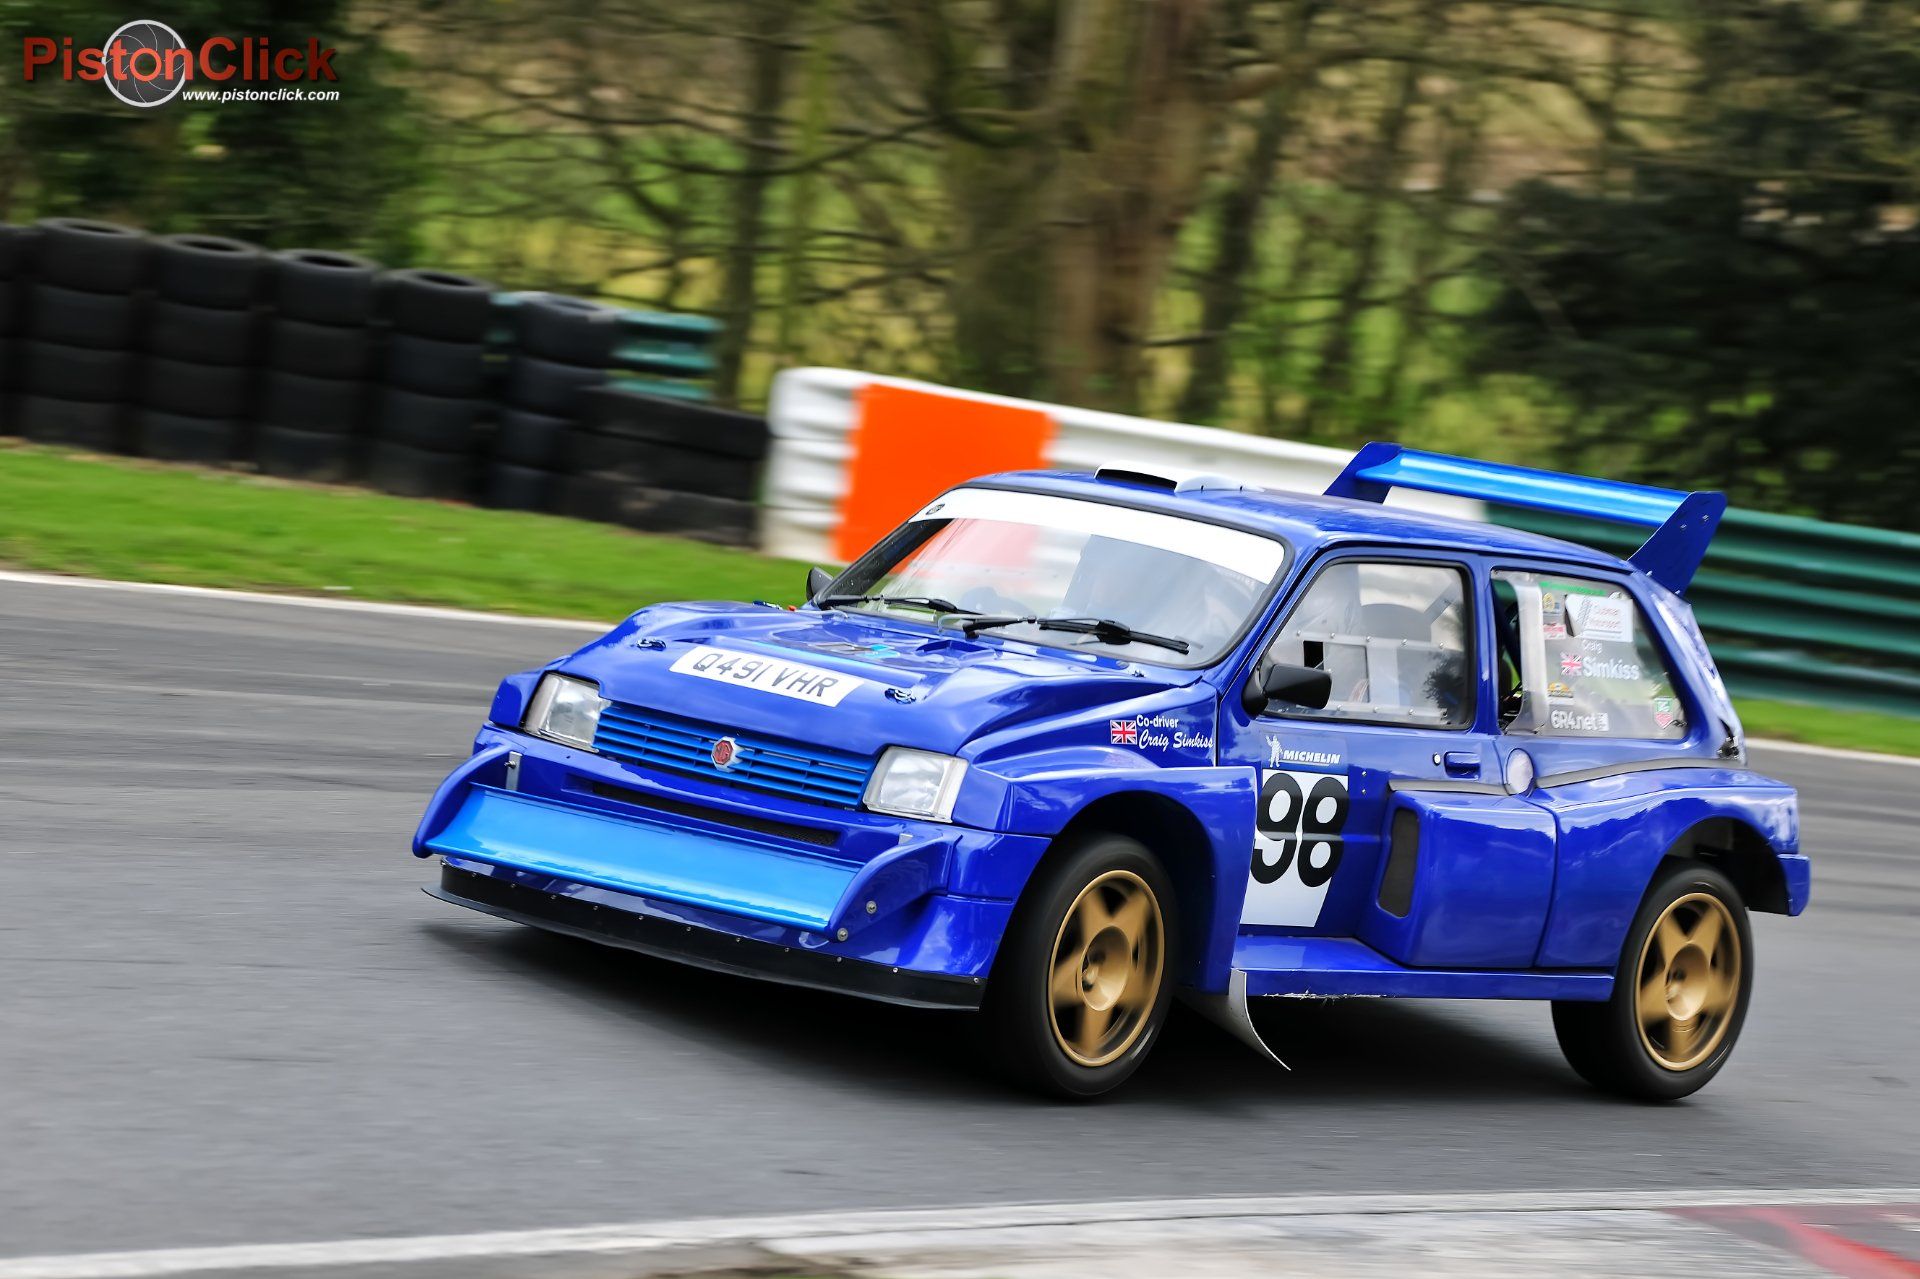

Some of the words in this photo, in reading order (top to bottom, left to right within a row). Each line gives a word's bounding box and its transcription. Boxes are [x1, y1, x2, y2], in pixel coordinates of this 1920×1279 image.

[693, 653, 773, 683] Q491
[771, 667, 839, 697] VHR
[1582, 657, 1639, 680] Simkiss
[1136, 714, 1179, 728] Co-driver
[1138, 728, 1169, 752] Craig
[1173, 731, 1214, 749] Simkiss
[1283, 749, 1341, 764] MICHELIN
[1250, 772, 1349, 887] 98
